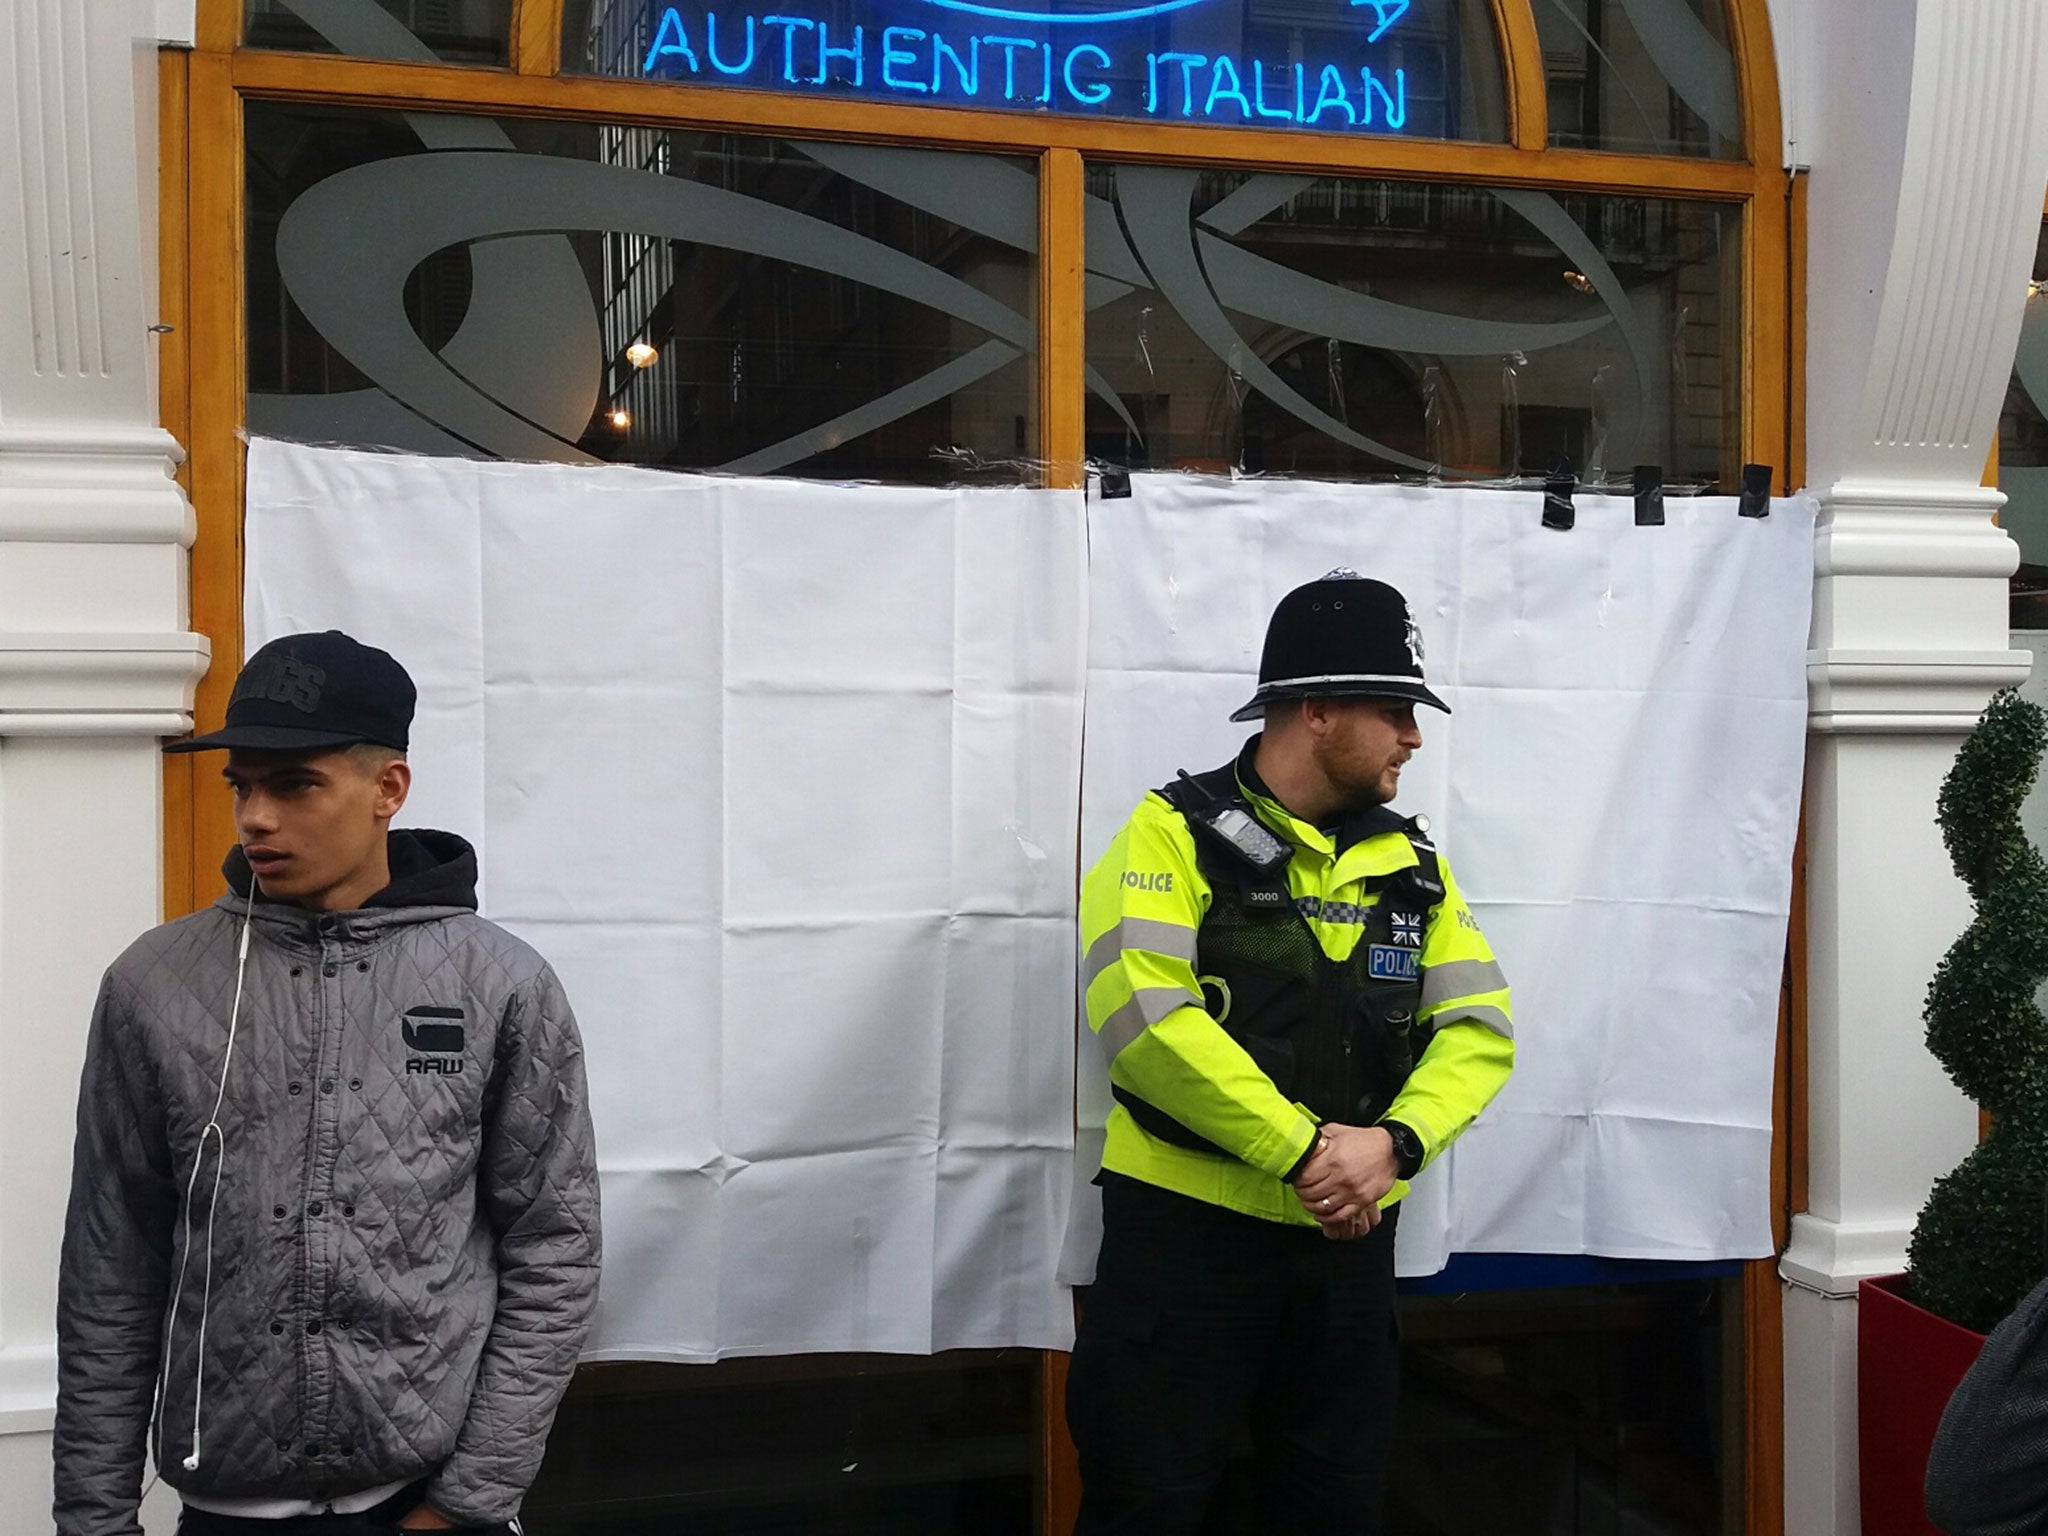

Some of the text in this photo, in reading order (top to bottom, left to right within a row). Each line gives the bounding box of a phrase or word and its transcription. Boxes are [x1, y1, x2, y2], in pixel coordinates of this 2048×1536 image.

[1145, 53, 1407, 129] ITALIAN
[1250, 892, 1279, 901] 3000
[405, 1058, 464, 1075] RAW
